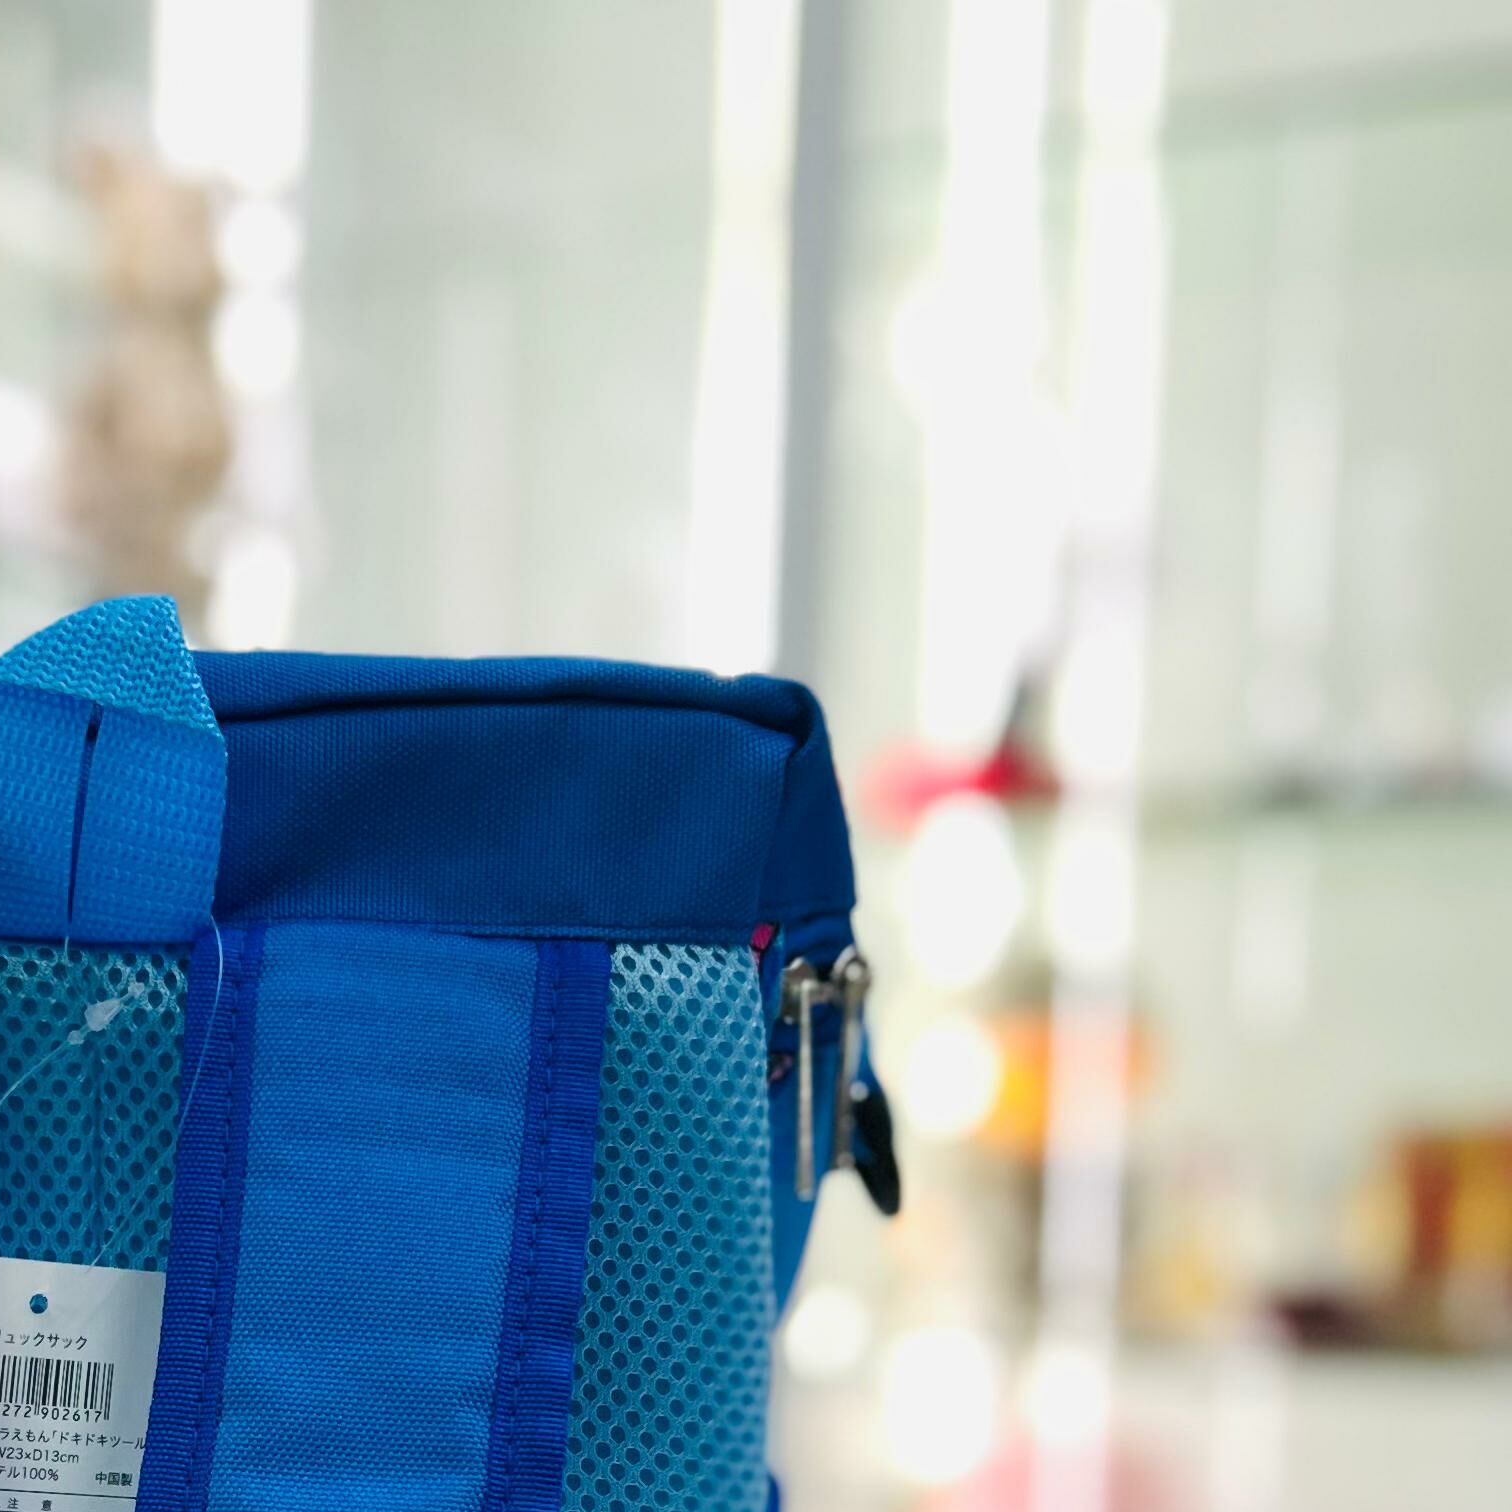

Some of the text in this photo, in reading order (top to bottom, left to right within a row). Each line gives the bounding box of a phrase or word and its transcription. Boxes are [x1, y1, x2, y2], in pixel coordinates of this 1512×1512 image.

[41, 1407, 102, 1423] 902617
[95, 1472, 133, 1486] 中国製
